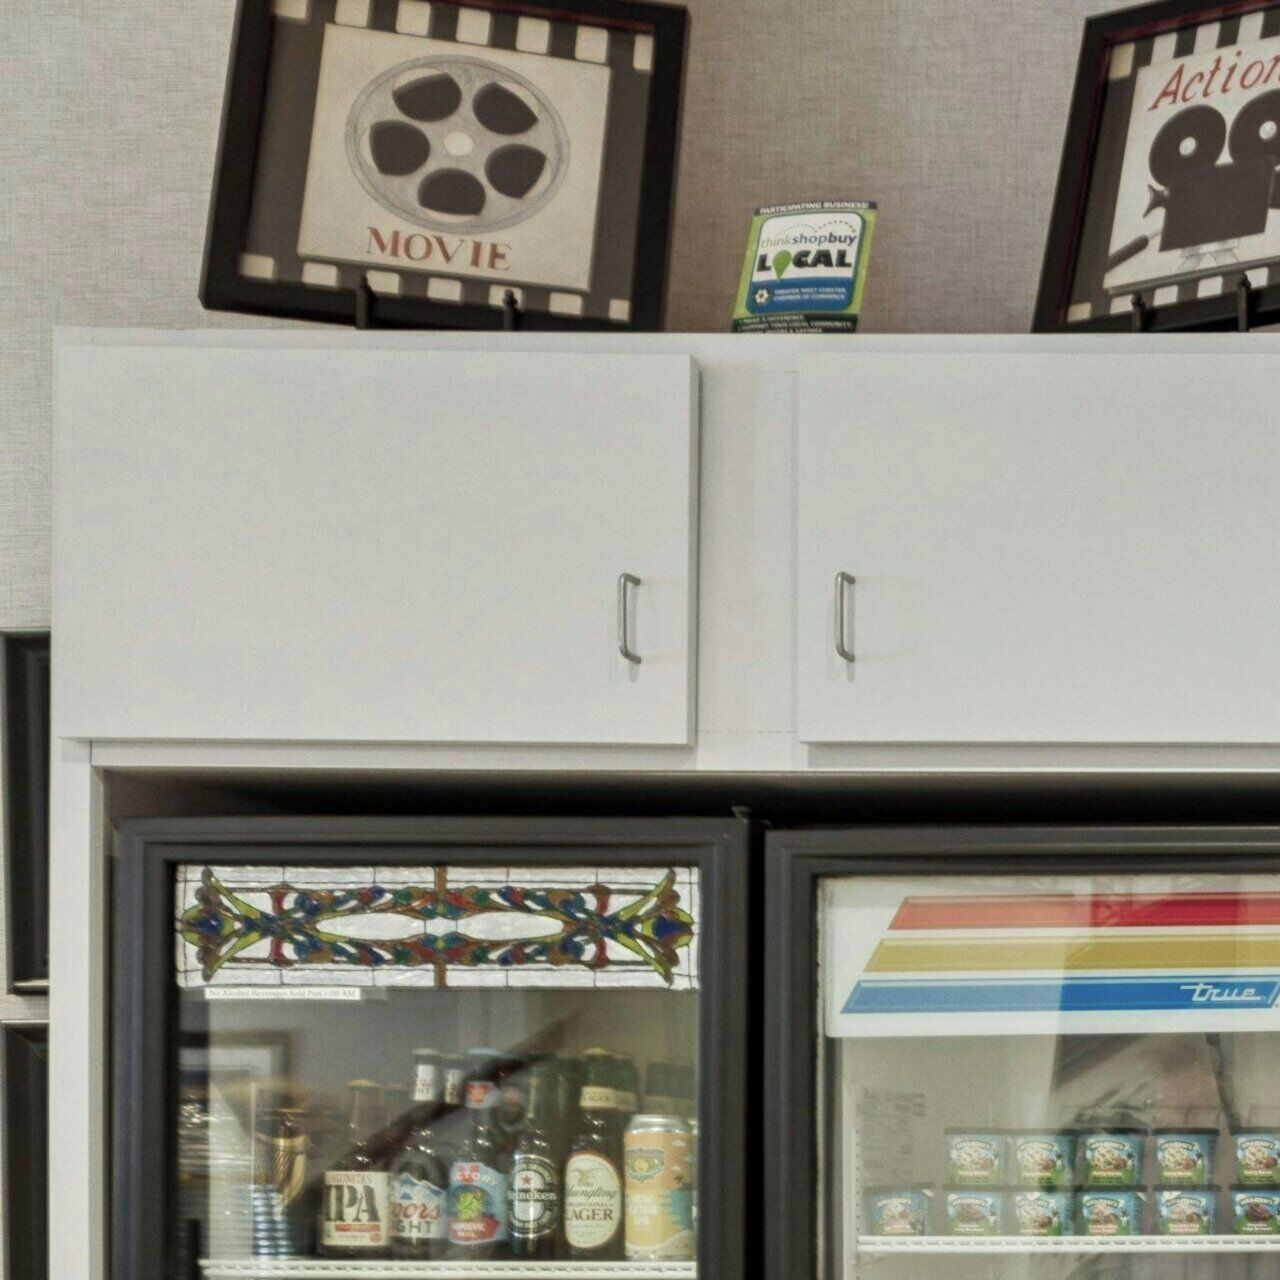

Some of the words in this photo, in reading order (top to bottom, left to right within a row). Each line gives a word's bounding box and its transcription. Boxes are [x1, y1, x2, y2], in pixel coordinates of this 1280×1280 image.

[760, 201, 822, 214] PARTICIPATING
[367, 226, 512, 272] MOVIE
[325, 1184, 380, 1222] IPA
